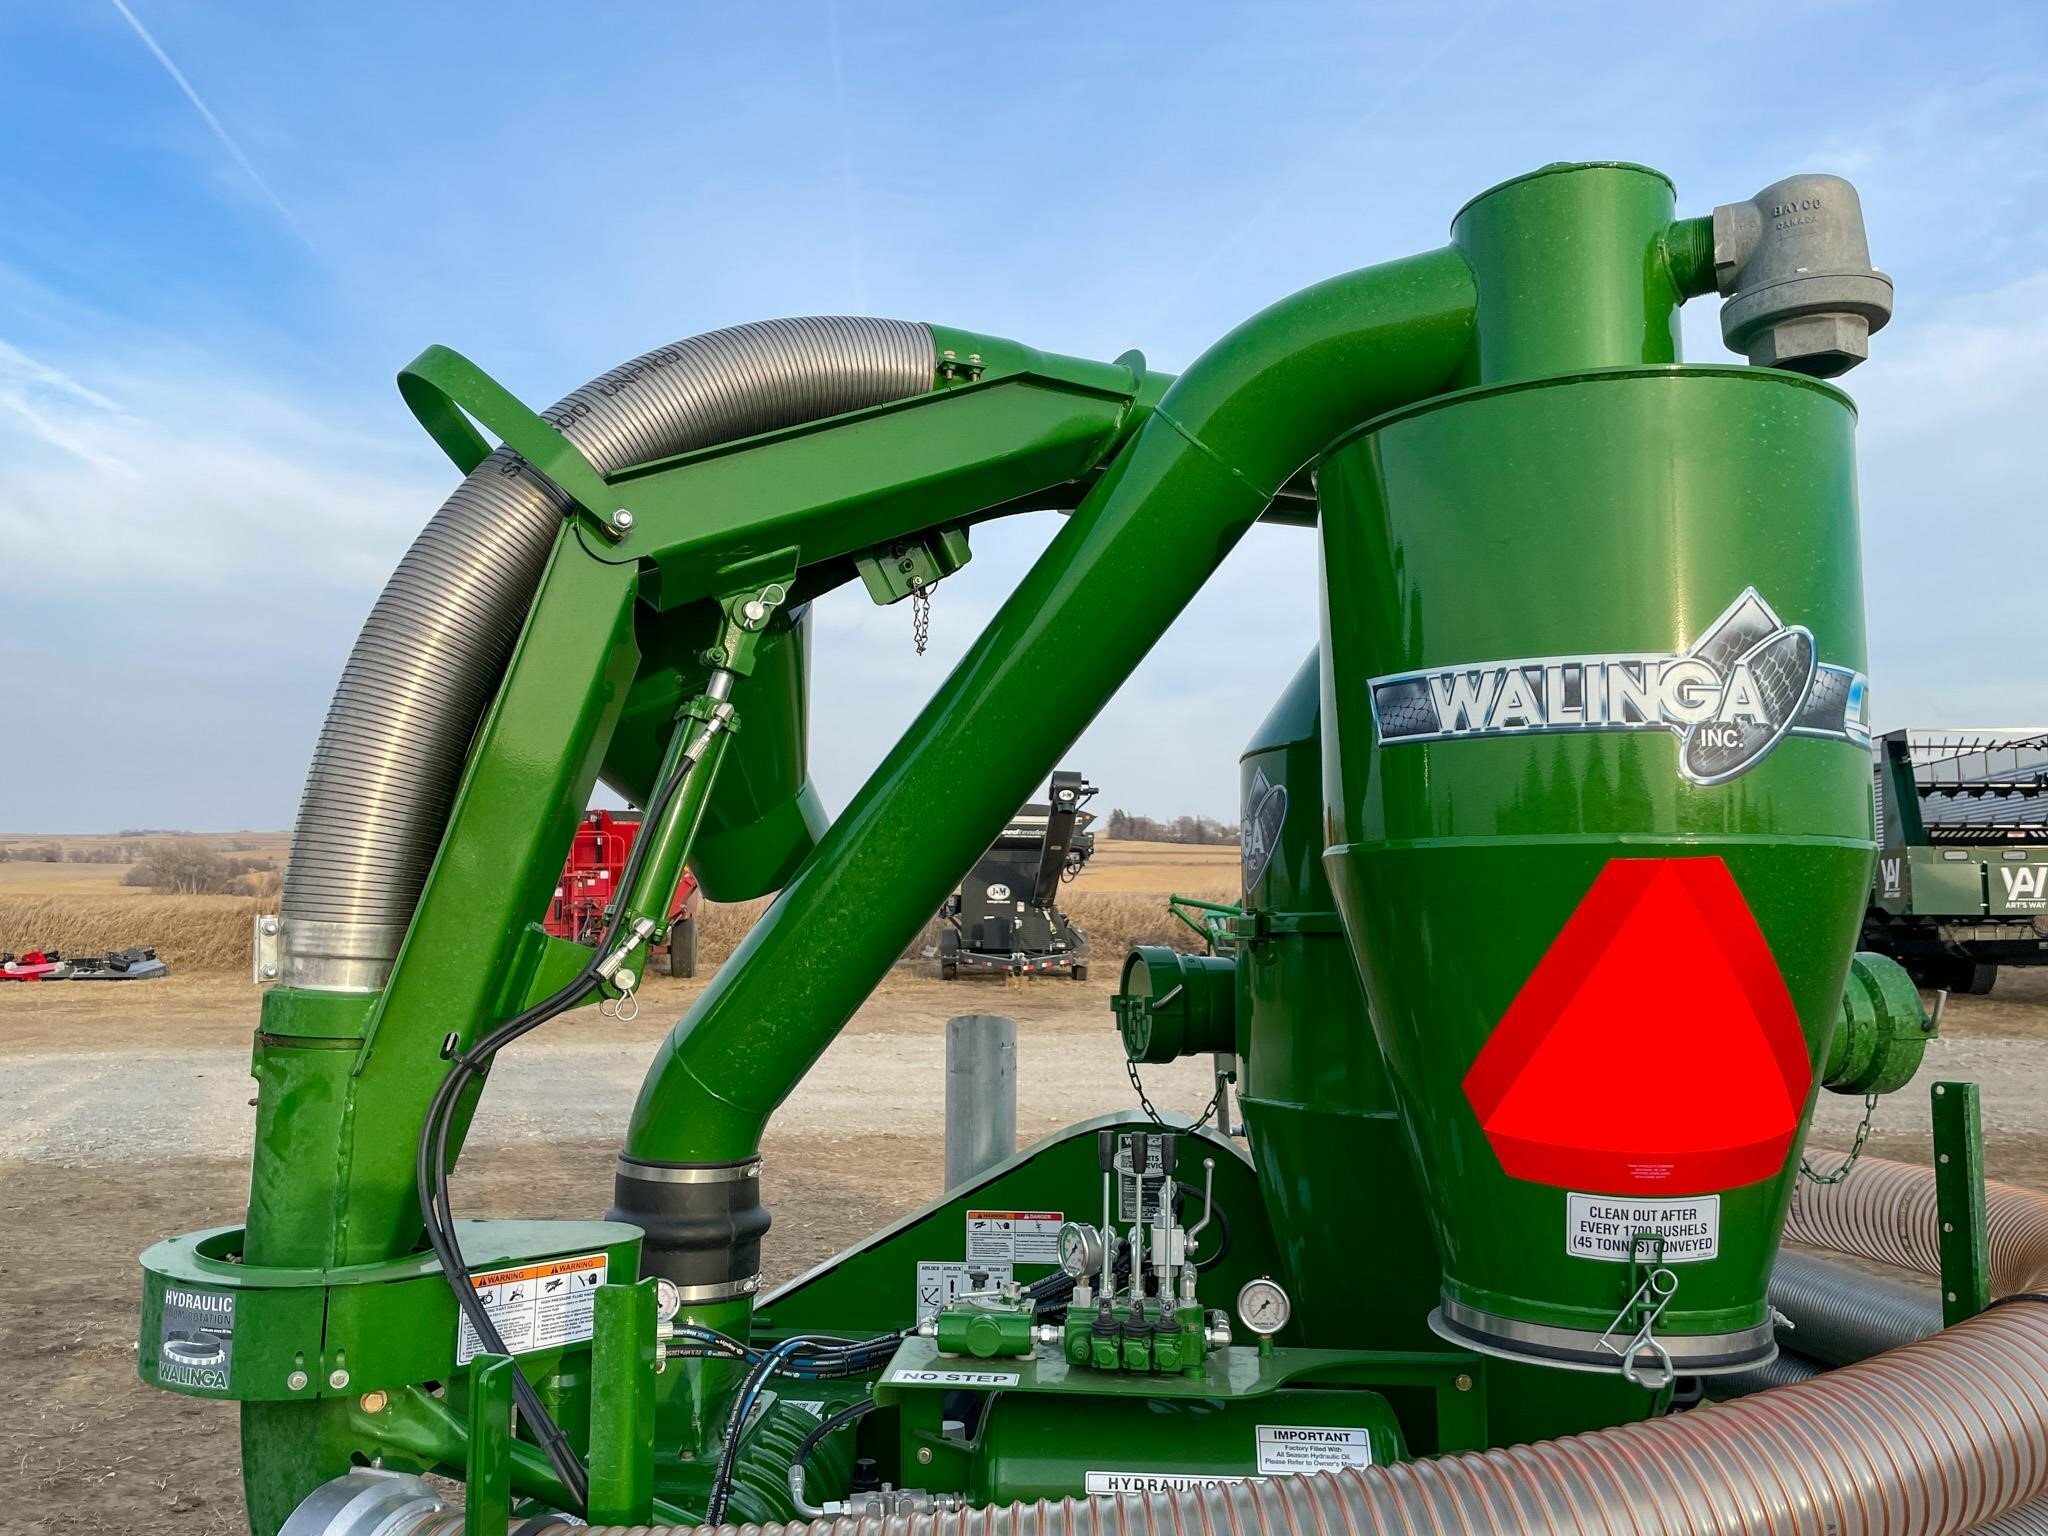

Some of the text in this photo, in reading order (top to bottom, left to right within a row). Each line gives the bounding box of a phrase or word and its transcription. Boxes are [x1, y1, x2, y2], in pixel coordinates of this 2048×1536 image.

[1774, 199, 1822, 218] BAYCO
[1428, 659, 1770, 732] WALINGA
[1700, 730, 1744, 749] INC.
[1590, 1206, 1697, 1222] CLEAN OUT AFTER
[1581, 1221, 1620, 1236] EVERY
[1656, 1223, 1707, 1238] BUSHELS
[1573, 1235, 1713, 1254] (45 TONNS) CONVEYED
[559, 1260, 594, 1273] WARNING
[487, 1271, 525, 1284] WARNING
[165, 1289, 233, 1312] HYDRAULIC
[159, 1360, 228, 1390] WALINGA
[903, 1373, 1008, 1383] NO STEP
[1274, 1430, 1351, 1442] IMPORTANT
[1285, 1445, 1308, 1453] Factory
[1311, 1453, 1340, 1461] Hydraulic
